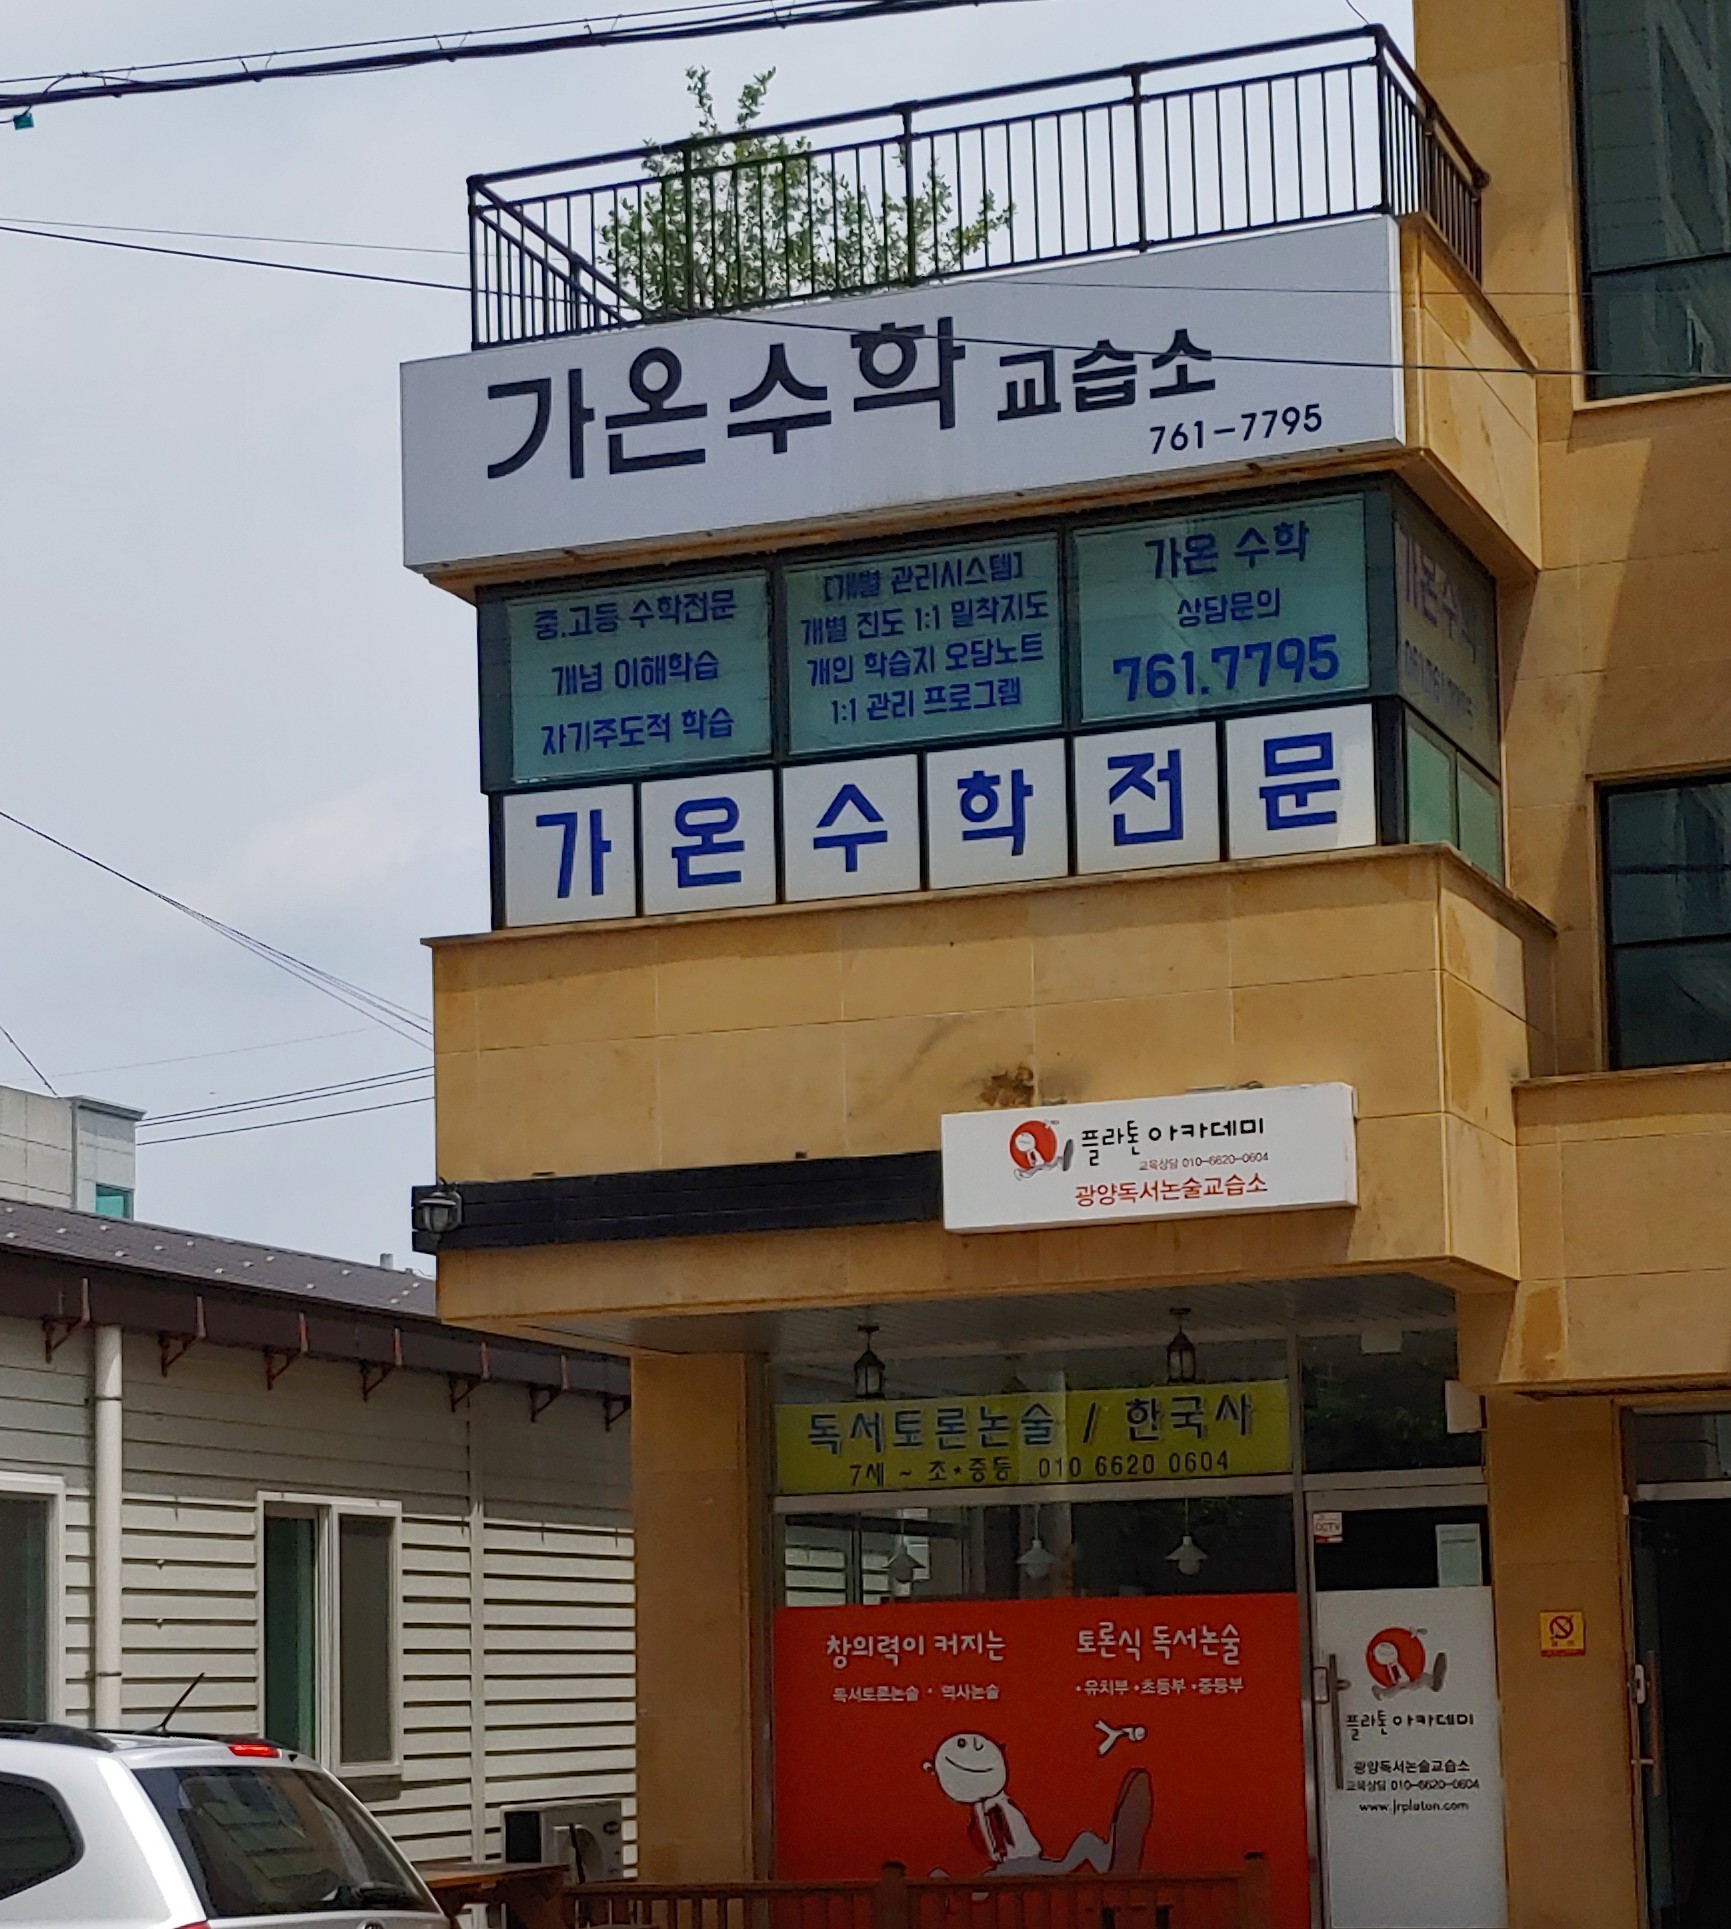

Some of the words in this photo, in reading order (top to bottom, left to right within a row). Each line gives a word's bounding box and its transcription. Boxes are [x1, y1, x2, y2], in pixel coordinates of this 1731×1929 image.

[486, 317, 966, 479] 가온수학
[997, 328, 1216, 421] 교습소
[1150, 403, 1323, 455] 761-7795
[1145, 533, 1219, 580] 가온
[1234, 519, 1310, 569] 수학
[629, 589, 736, 629] 수학전문
[801, 615, 848, 646] 개별
[856, 608, 905, 639] 진도
[915, 604, 940, 632] 1:1
[950, 590, 1049, 628] 밀착지도
[1177, 587, 1281, 628] 상담문의
[551, 661, 603, 696] 개념
[614, 650, 719, 689] 이해학습
[807, 655, 854, 687] 개인
[864, 646, 935, 679] 학습지
[1112, 634, 1340, 702] 761.7795
[831, 698, 856, 725] 1:1
[867, 690, 914, 721] 관리
[922, 677, 1021, 715] 프로그램
[540, 712, 671, 756] 자기주도적
[681, 707, 735, 740] 학습
[1074, 1172, 1269, 1208] 광양독서논술교습소
[806, 1401, 1056, 1454] 독서토론논술
[1125, 1393, 1252, 1442] 한국사
[849, 1461, 885, 1487] 7세
[1038, 1456, 1081, 1479] 010
[1094, 1453, 1155, 1476] 6620
[1167, 1449, 1228, 1473] 0604
[826, 1634, 925, 1669] 창의력이
[934, 1629, 1007, 1662] 커지는
[1076, 1621, 1141, 1662] 토론식
[1151, 1623, 1241, 1666] 독서논술
